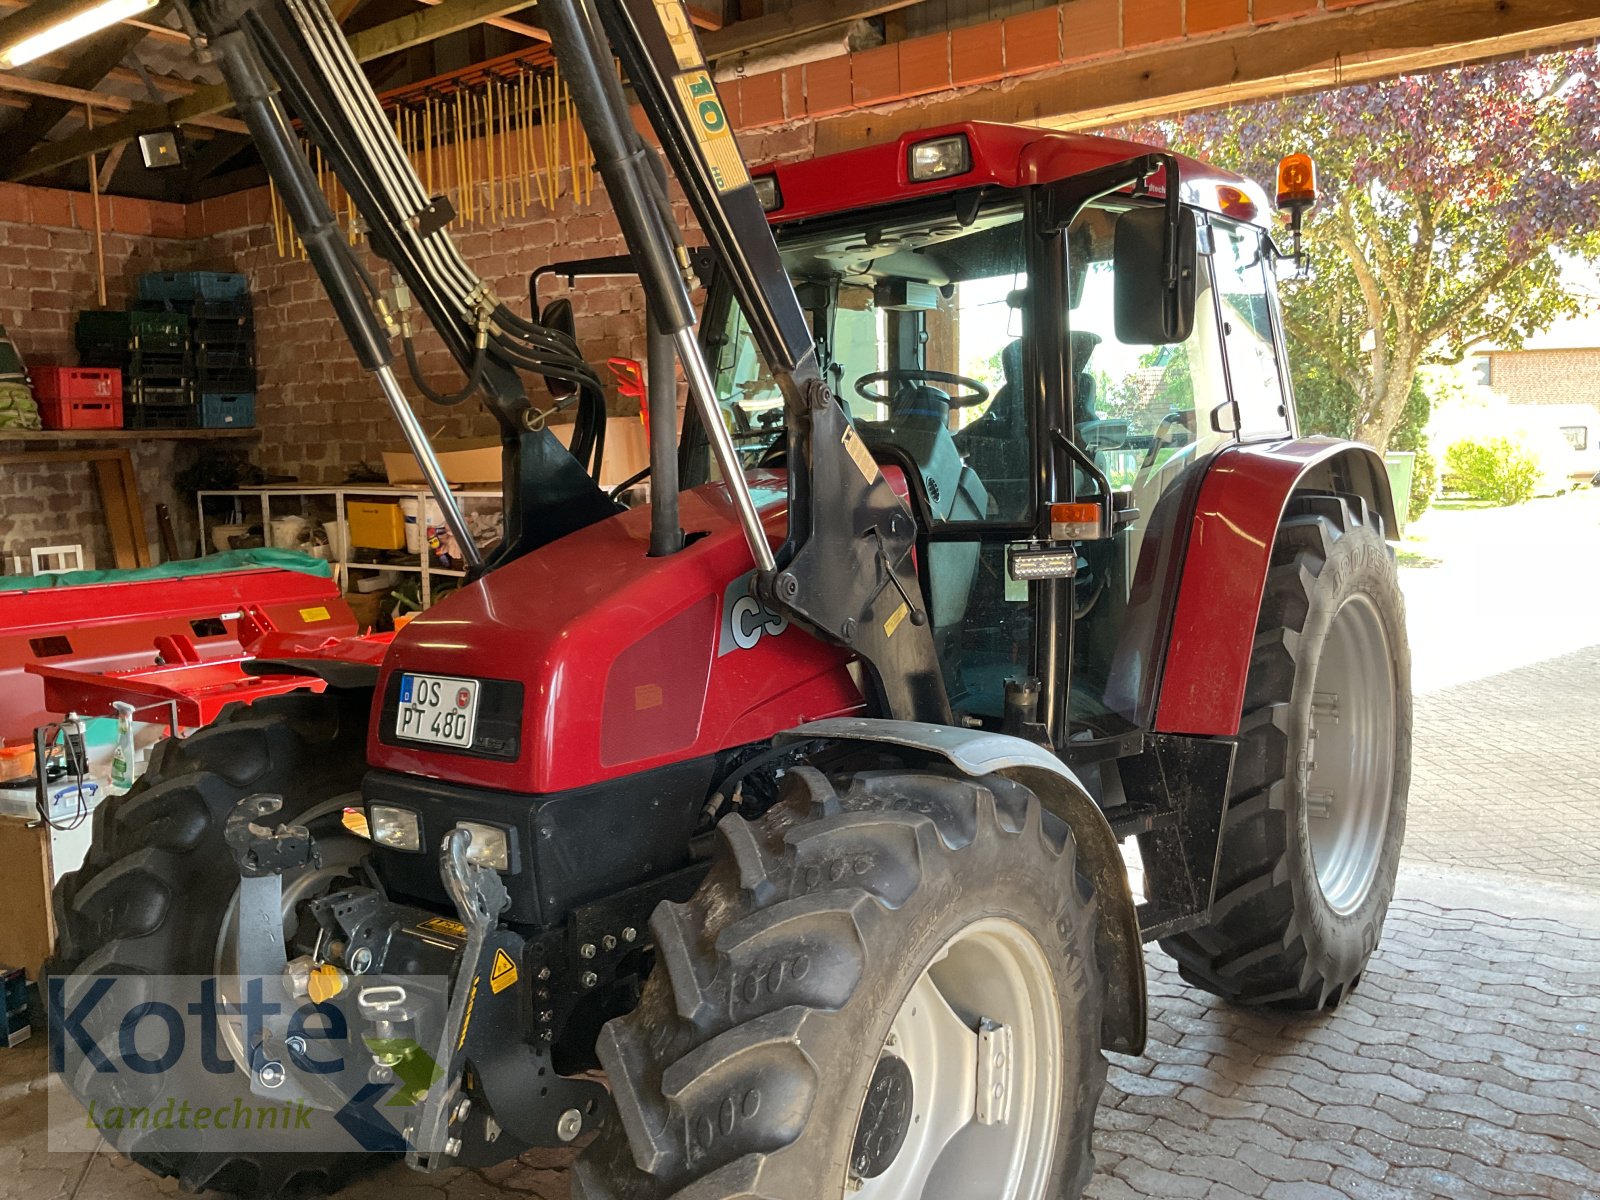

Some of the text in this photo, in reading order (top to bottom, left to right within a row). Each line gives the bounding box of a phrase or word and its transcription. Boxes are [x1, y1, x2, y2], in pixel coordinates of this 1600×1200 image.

[653, 0, 726, 134] ST 10
[710, 166, 725, 188] HD
[417, 679, 442, 707] OS
[402, 707, 466, 740] PT 480
